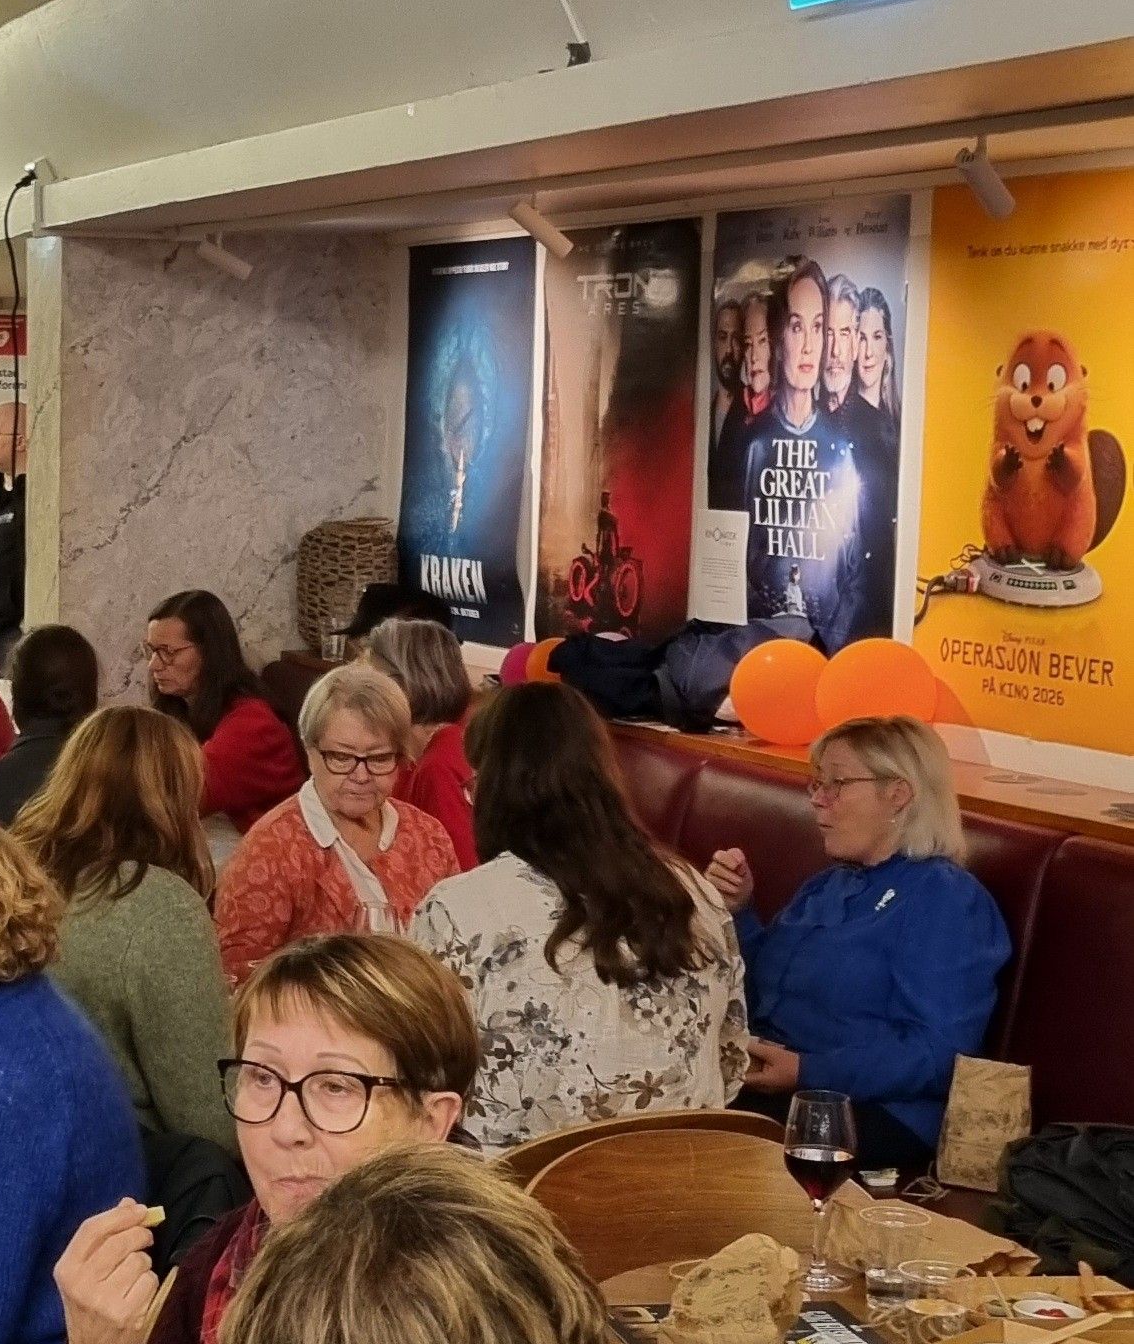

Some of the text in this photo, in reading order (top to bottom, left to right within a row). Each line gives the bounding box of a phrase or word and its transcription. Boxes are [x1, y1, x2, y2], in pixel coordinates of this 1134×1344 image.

[772, 439, 818, 469] THE
[760, 468, 831, 499] GREAT
[754, 497, 836, 531] LILLIAN
[767, 528, 825, 561] HALL
[420, 553, 488, 605] KRAKEN
[940, 637, 1114, 687] OPERASJON BEVER
[982, 676, 1065, 706] PÅ KINO 2026
